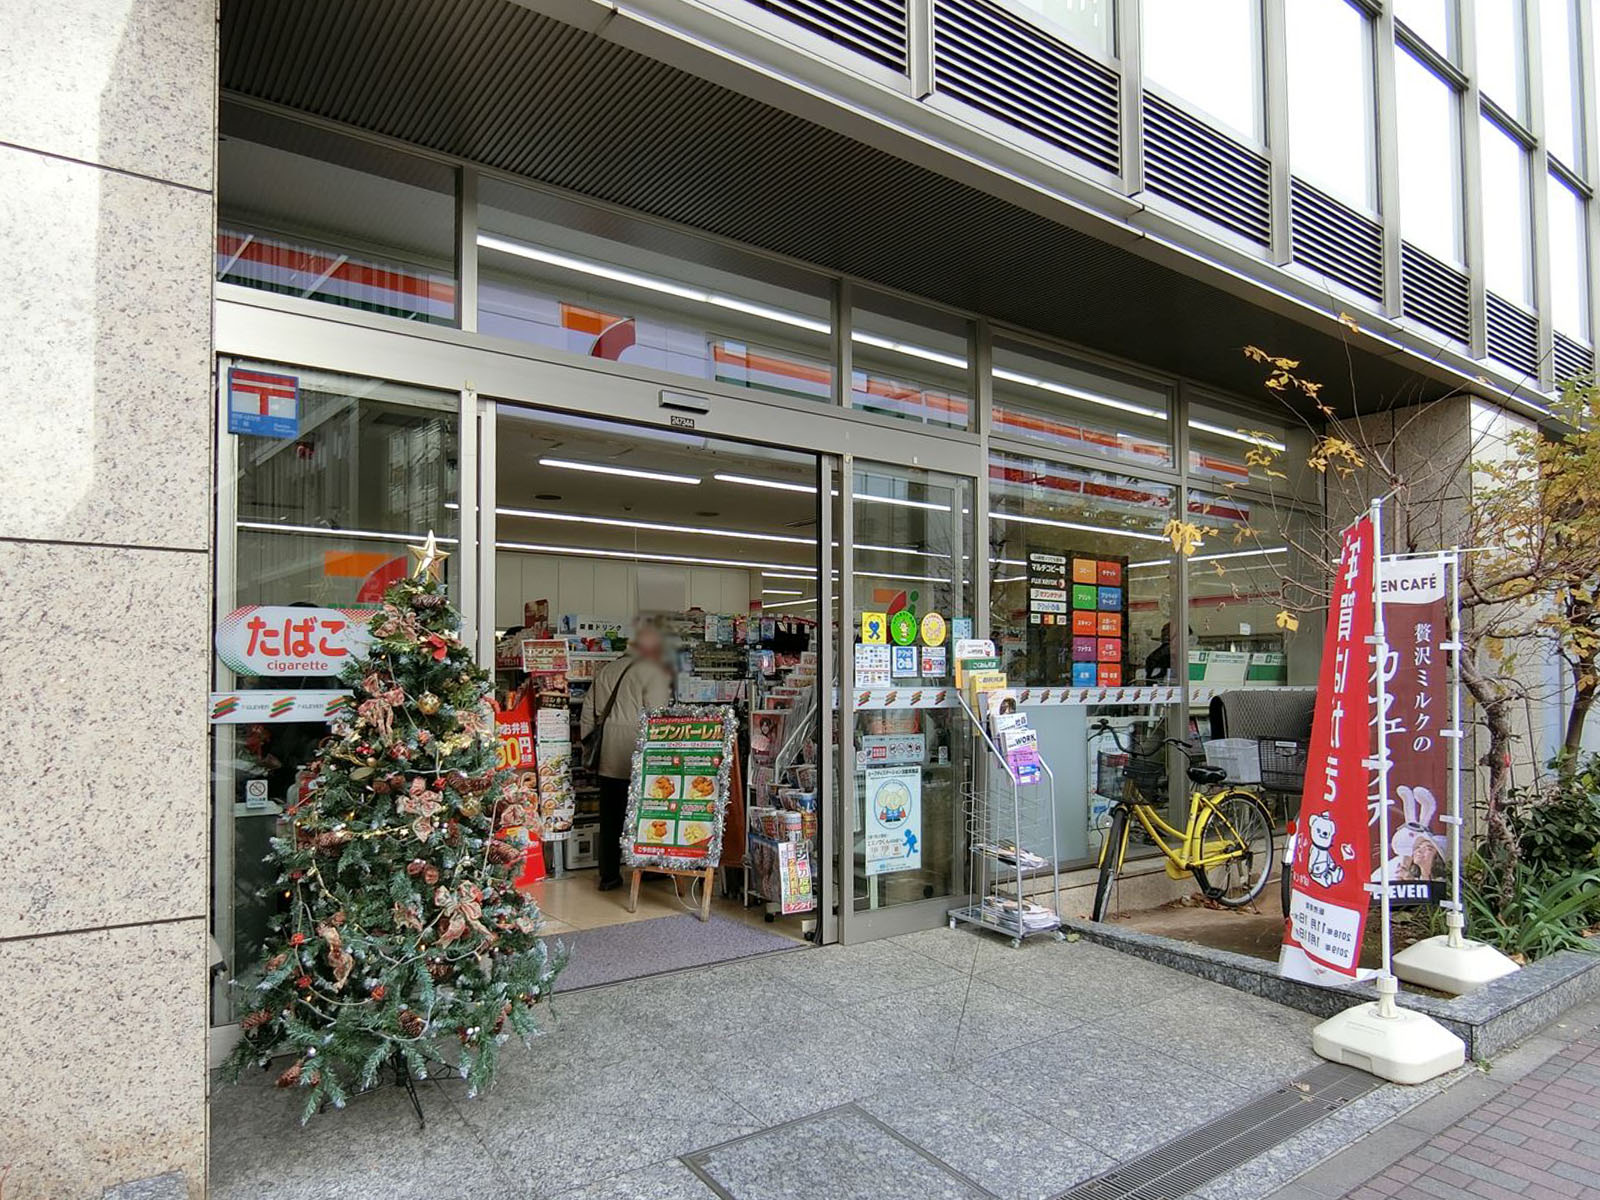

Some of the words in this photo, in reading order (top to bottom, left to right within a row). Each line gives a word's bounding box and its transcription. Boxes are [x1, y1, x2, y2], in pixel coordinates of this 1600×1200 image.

[1400, 573, 1437, 591] CAFÉ
[579, 623, 622, 632] ドリンク
[247, 616, 348, 658] たばこ
[266, 660, 329, 673] cigarette
[1413, 622, 1432, 752] 贅沢ミルクの
